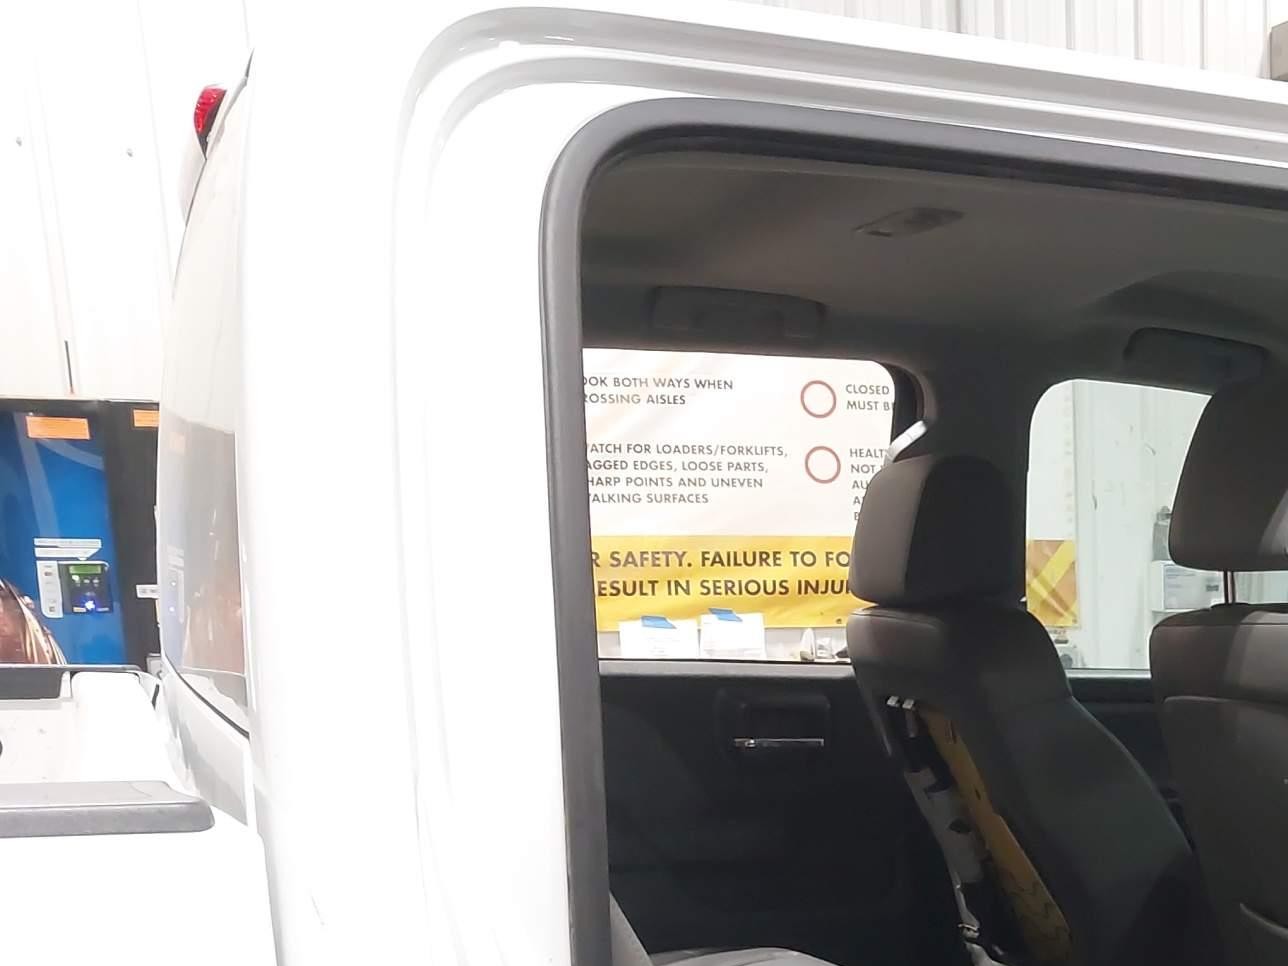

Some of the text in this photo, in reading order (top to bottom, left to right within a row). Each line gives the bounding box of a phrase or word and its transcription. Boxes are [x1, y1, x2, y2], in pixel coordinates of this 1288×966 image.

[613, 377, 648, 388] BOTH
[653, 378, 690, 388] WAYS
[694, 379, 733, 389] WHEN
[845, 384, 889, 395] CLOSED
[647, 394, 686, 405] AISLES
[847, 400, 879, 410] MUST
[587, 443, 788, 458] ATCH FOR LOADERS/FORKLIFTS,
[634, 460, 678, 472] EDGES,
[682, 461, 722, 471] LOOSE
[727, 461, 768, 473] PARTS,
[850, 464, 876, 474] NOT
[626, 477, 673, 487] POINTS
[678, 477, 706, 487] AND
[711, 478, 763, 488] UNEVEN
[589, 493, 709, 504] ALKING SURFACES
[609, 551, 692, 567] SAFETY.
[701, 551, 782, 567] FAILURE
[790, 551, 816, 567] TO
[667, 580, 690, 596] IN
[700, 579, 789, 596] SERIOUS
[798, 579, 850, 595] INJU
